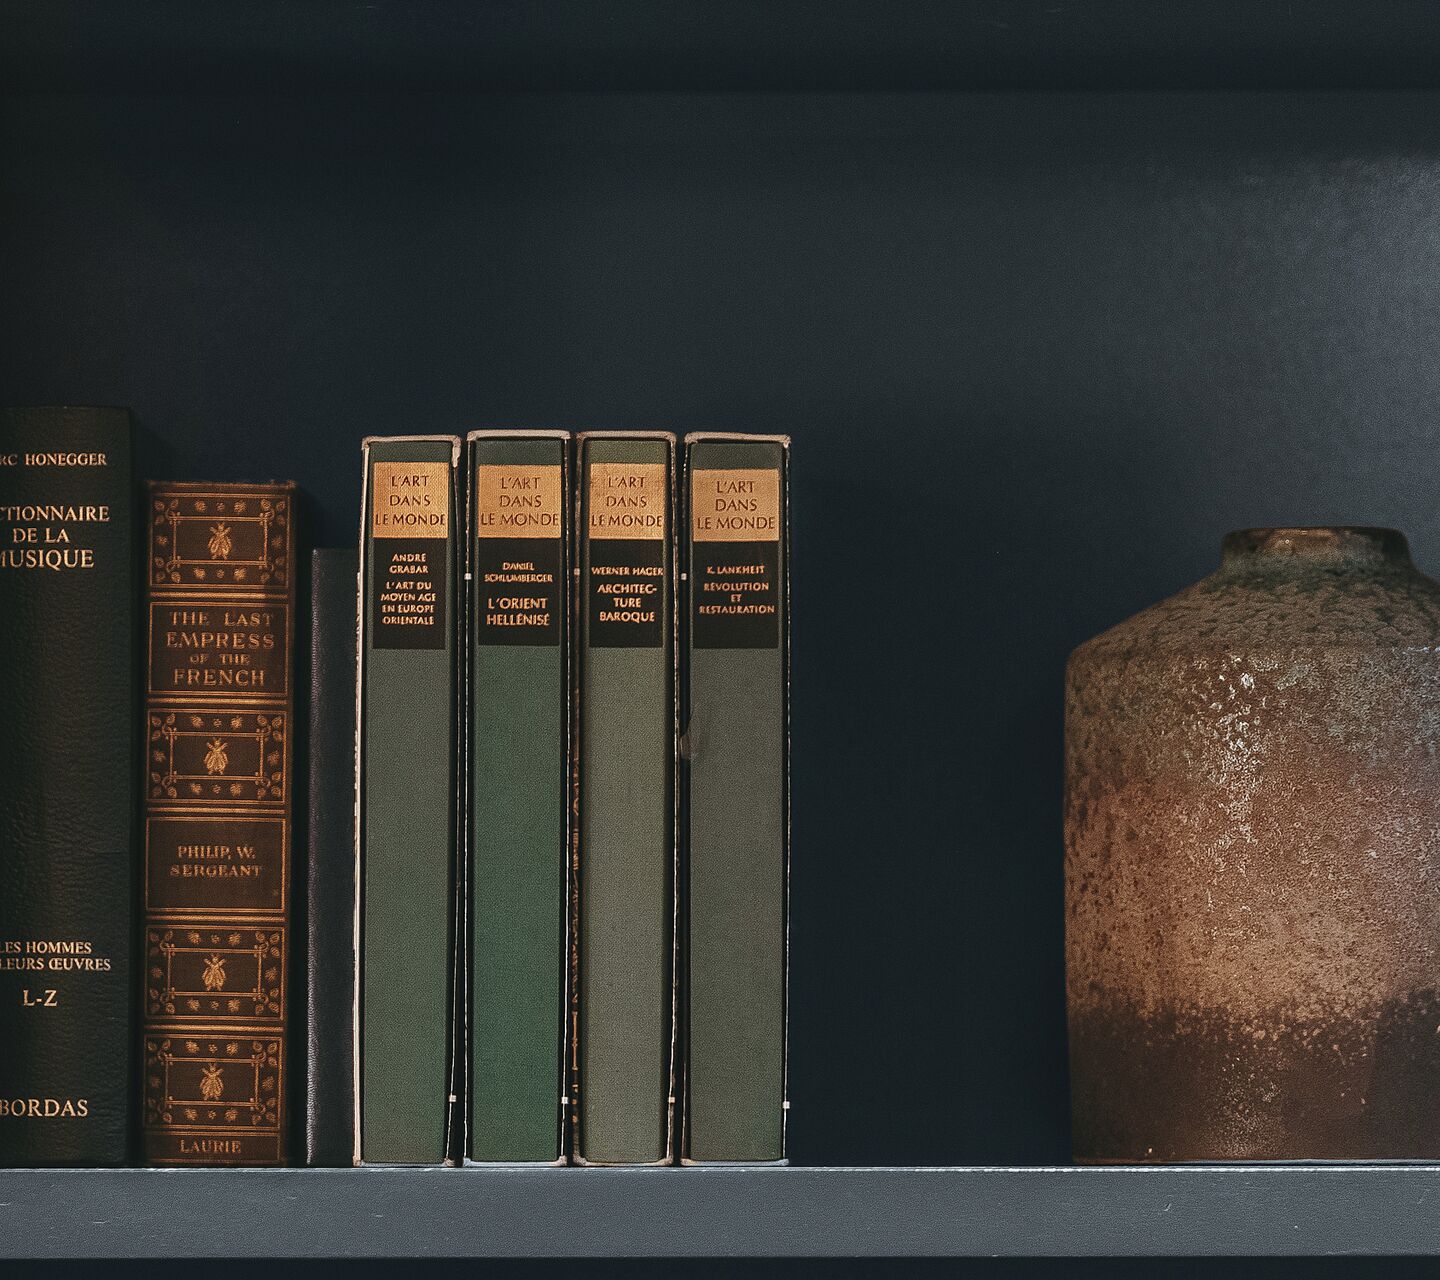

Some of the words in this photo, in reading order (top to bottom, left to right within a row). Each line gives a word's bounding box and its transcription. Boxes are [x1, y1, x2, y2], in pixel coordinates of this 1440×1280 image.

[25, 453, 108, 467] HONEGGER
[391, 475, 430, 488] L'ART
[501, 477, 540, 490] L'ART
[608, 476, 646, 489] L'ART
[716, 481, 755, 494] L'ART
[389, 494, 431, 507] DANS
[500, 495, 542, 508] DANS
[606, 496, 647, 508] DANS
[715, 498, 757, 511] DANS
[375, 514, 388, 526] LE
[392, 513, 446, 526] MONDE
[480, 513, 495, 526] LE
[500, 513, 559, 526] MONDE
[591, 515, 605, 527] LE
[608, 514, 663, 528] MONDE
[697, 517, 712, 530] LE
[716, 516, 775, 530] MONDE
[12, 528, 38, 543] DE
[44, 528, 70, 543] LA
[389, 565, 429, 574] GRABAR
[502, 562, 535, 571] DANIEL
[591, 567, 630, 576] WERNER
[633, 567, 664, 576] HAGER
[717, 565, 765, 574] LANKHEIT
[485, 574, 553, 583] SCHLUMBERGER
[417, 581, 432, 590] DU
[597, 583, 657, 594] ARCHITEC-
[380, 593, 416, 602] MOYEN
[417, 593, 437, 602] AGE
[487, 597, 548, 610] L'ORIENT
[613, 597, 642, 608] TURE
[730, 594, 742, 602] ET
[382, 604, 395, 613] EN
[398, 604, 435, 614] EUROPE
[699, 605, 775, 615] RESTAURATION
[170, 612, 209, 626] THE
[224, 612, 273, 627] LAST
[382, 616, 435, 626] ORIENTALE
[599, 611, 655, 623] BAROQUE
[166, 632, 275, 649] EMPRESS
[219, 654, 250, 665] THE
[173, 669, 265, 687] FRENCH
[170, 864, 262, 878] SERGEANT
[26, 941, 92, 955] HOMMES
[48, 958, 111, 971] ŒUVRES
[23, 989, 58, 1007] L-Z
[180, 1140, 241, 1154] LAURIE
